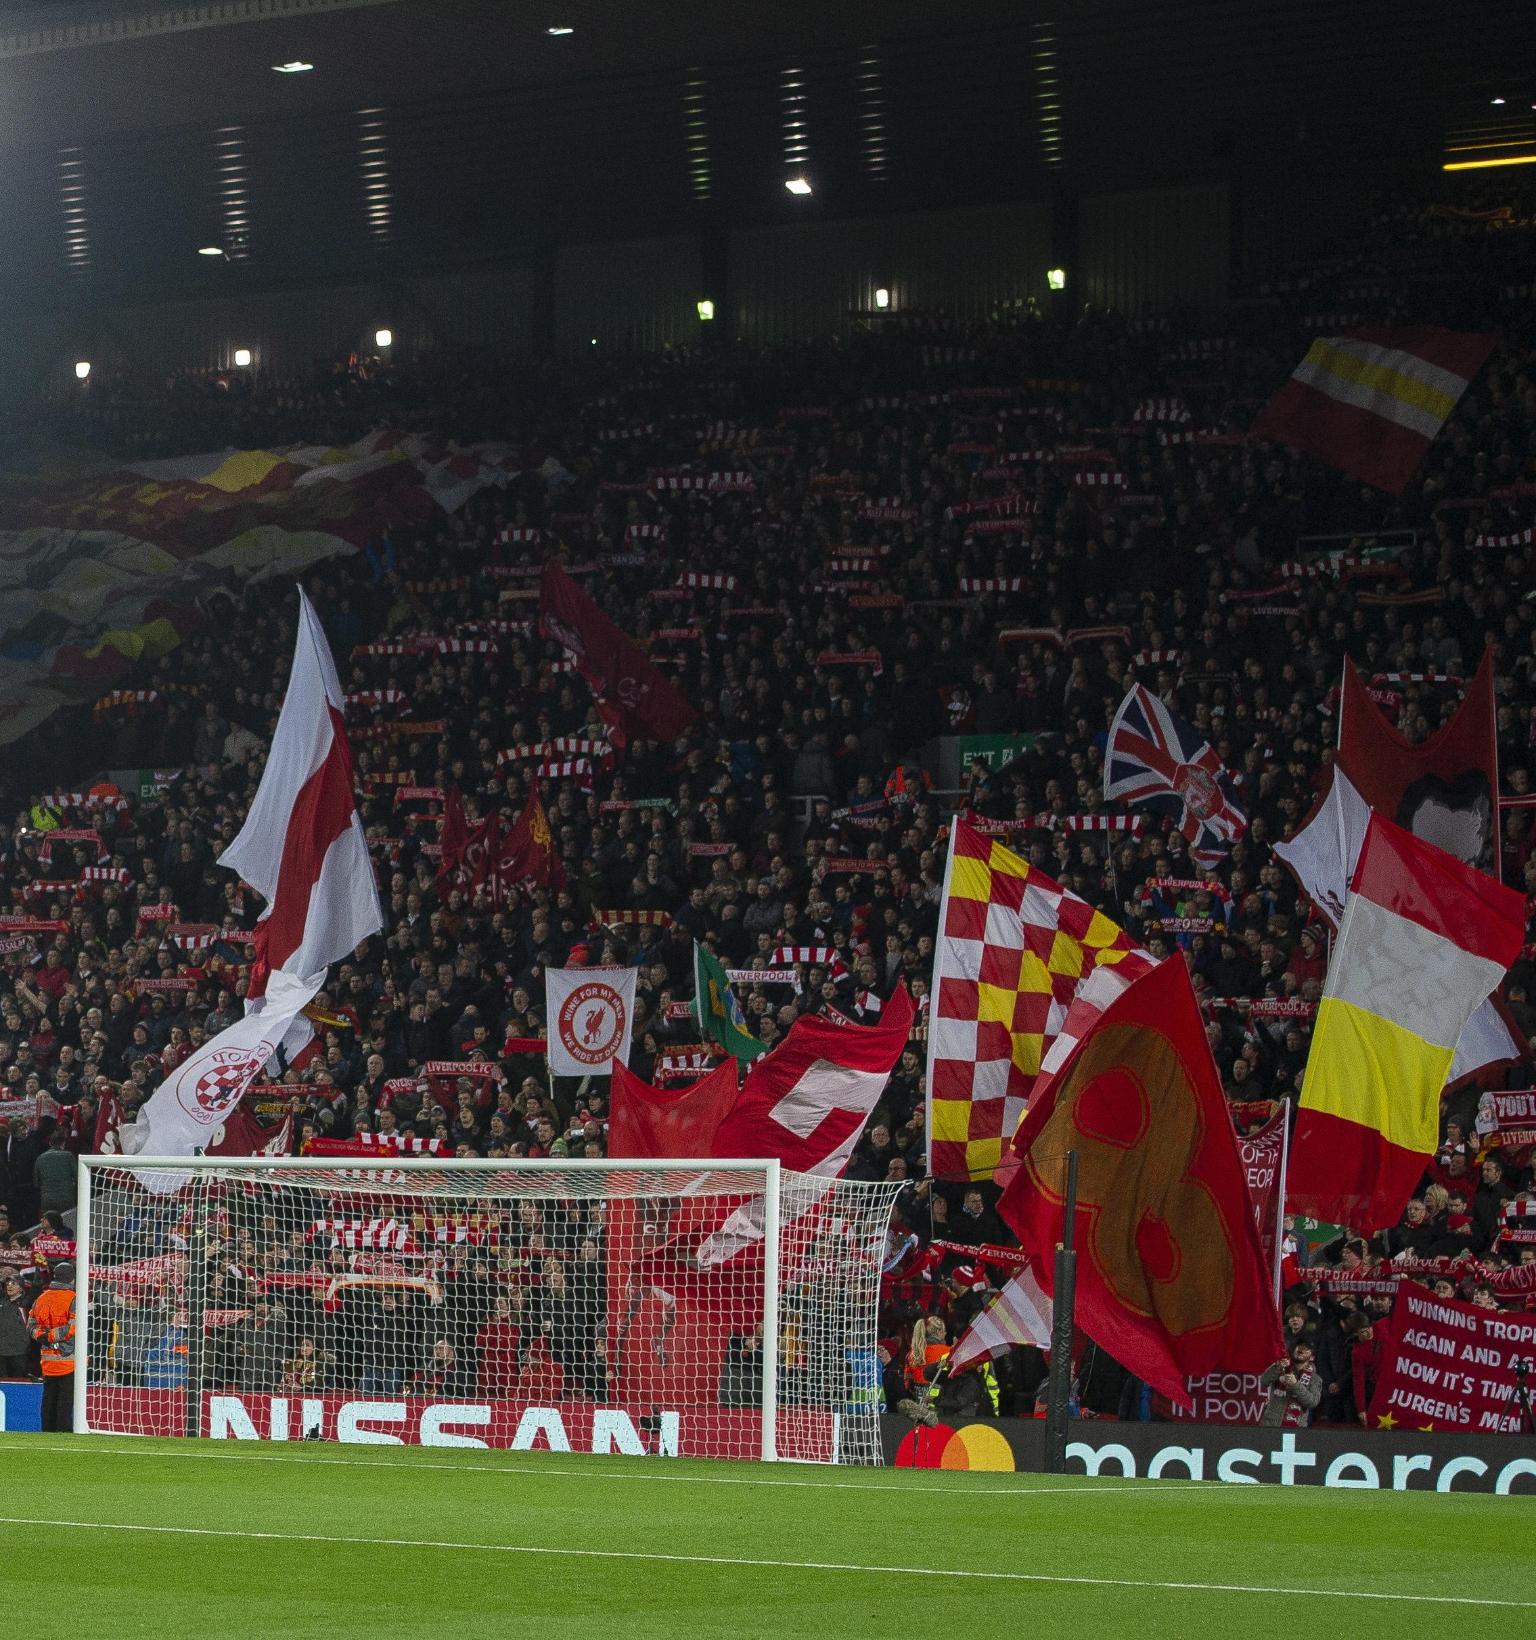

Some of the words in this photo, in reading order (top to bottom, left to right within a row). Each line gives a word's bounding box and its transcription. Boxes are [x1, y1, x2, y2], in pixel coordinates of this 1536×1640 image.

[730, 970, 793, 981] LIVERPOOL
[426, 1061, 477, 1073] LIVERPOOL
[477, 1062, 492, 1073] FC
[34, 1239, 71, 1251] LIVERPOOL
[1407, 1296, 1477, 1331] WINNING
[1402, 1327, 1456, 1358] AGAIN
[1460, 1347, 1501, 1368] AND
[1188, 1372, 1269, 1394] PEOPL
[1394, 1356, 1438, 1385] NOW
[1441, 1372, 1476, 1396] IT'S
[1195, 1400, 1265, 1423] POW
[1387, 1387, 1472, 1426] JURGEN'S
[209, 1395, 680, 1457] NISSAN
